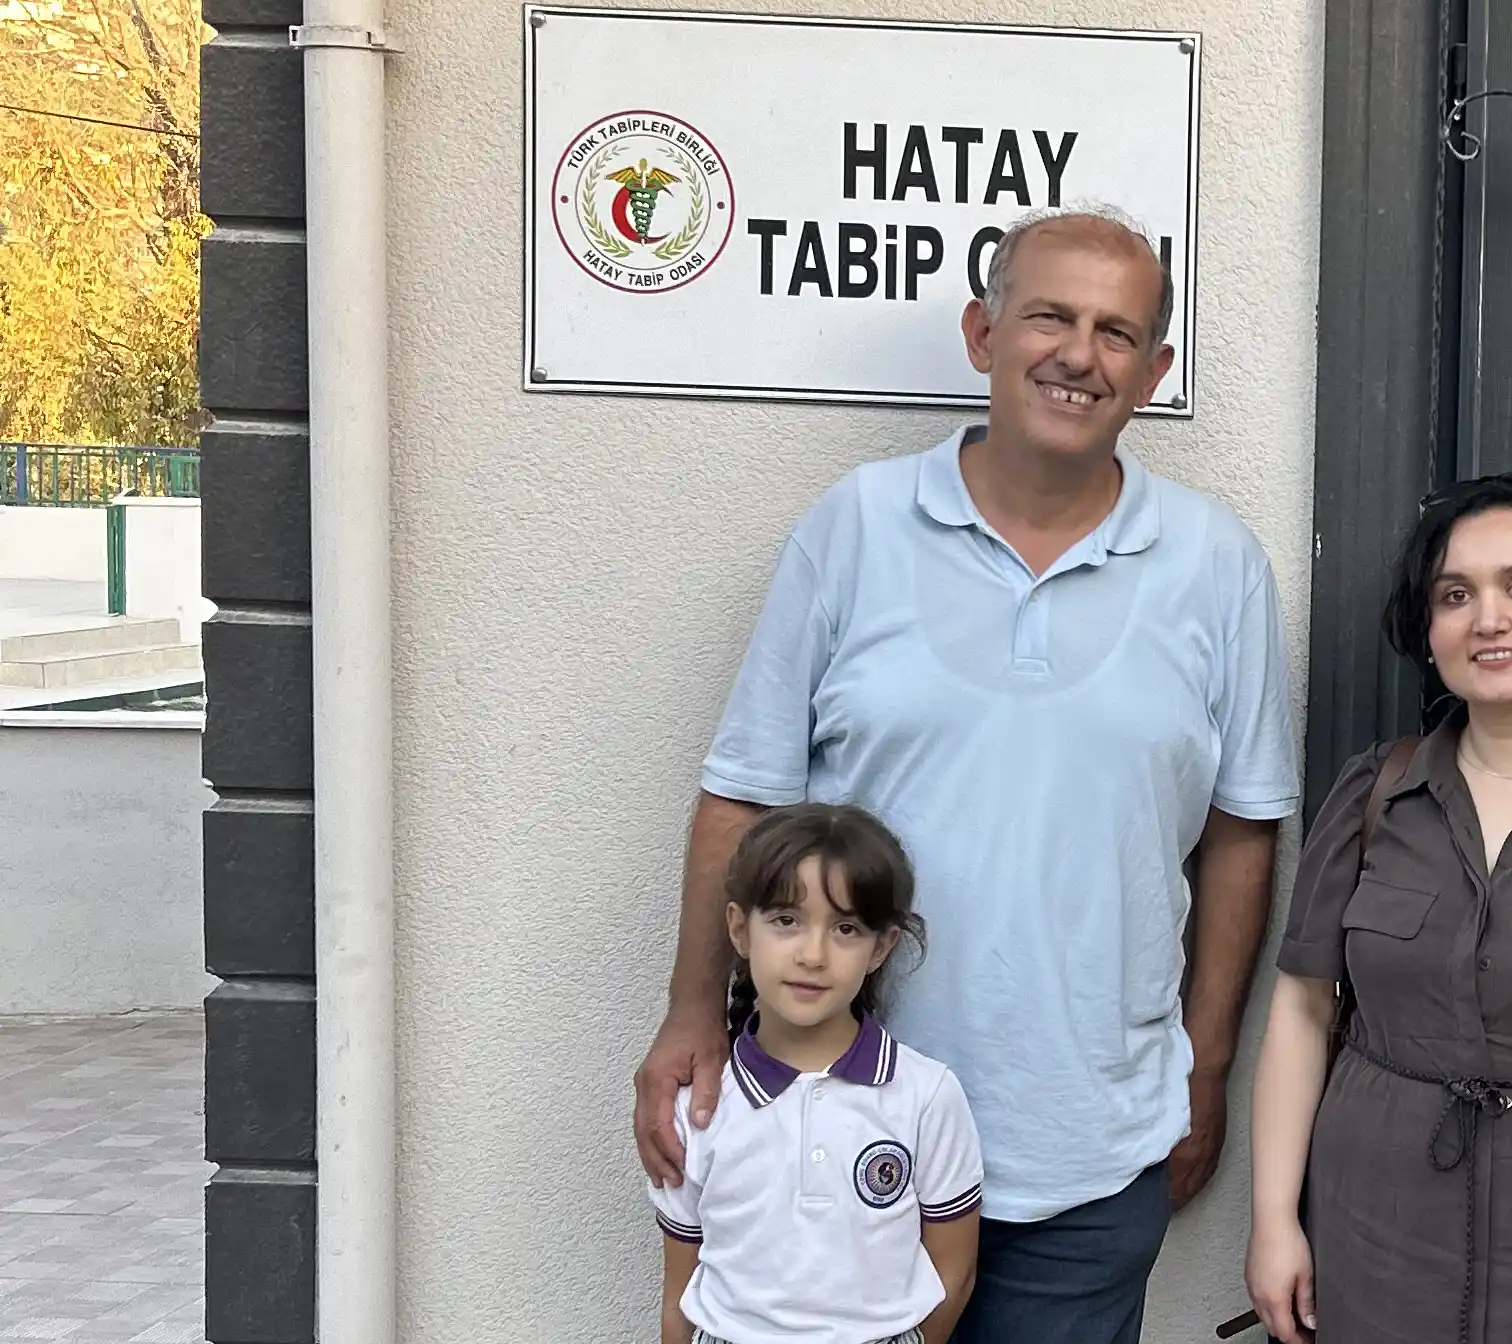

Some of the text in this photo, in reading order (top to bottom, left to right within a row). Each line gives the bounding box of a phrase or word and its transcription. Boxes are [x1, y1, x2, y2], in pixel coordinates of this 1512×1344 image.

[567, 117, 720, 176] TÜRK TABİPLERİ BİRLİĞİ
[843, 121, 1079, 208] HATAY
[582, 250, 706, 287] HATAY TABİP ODASI
